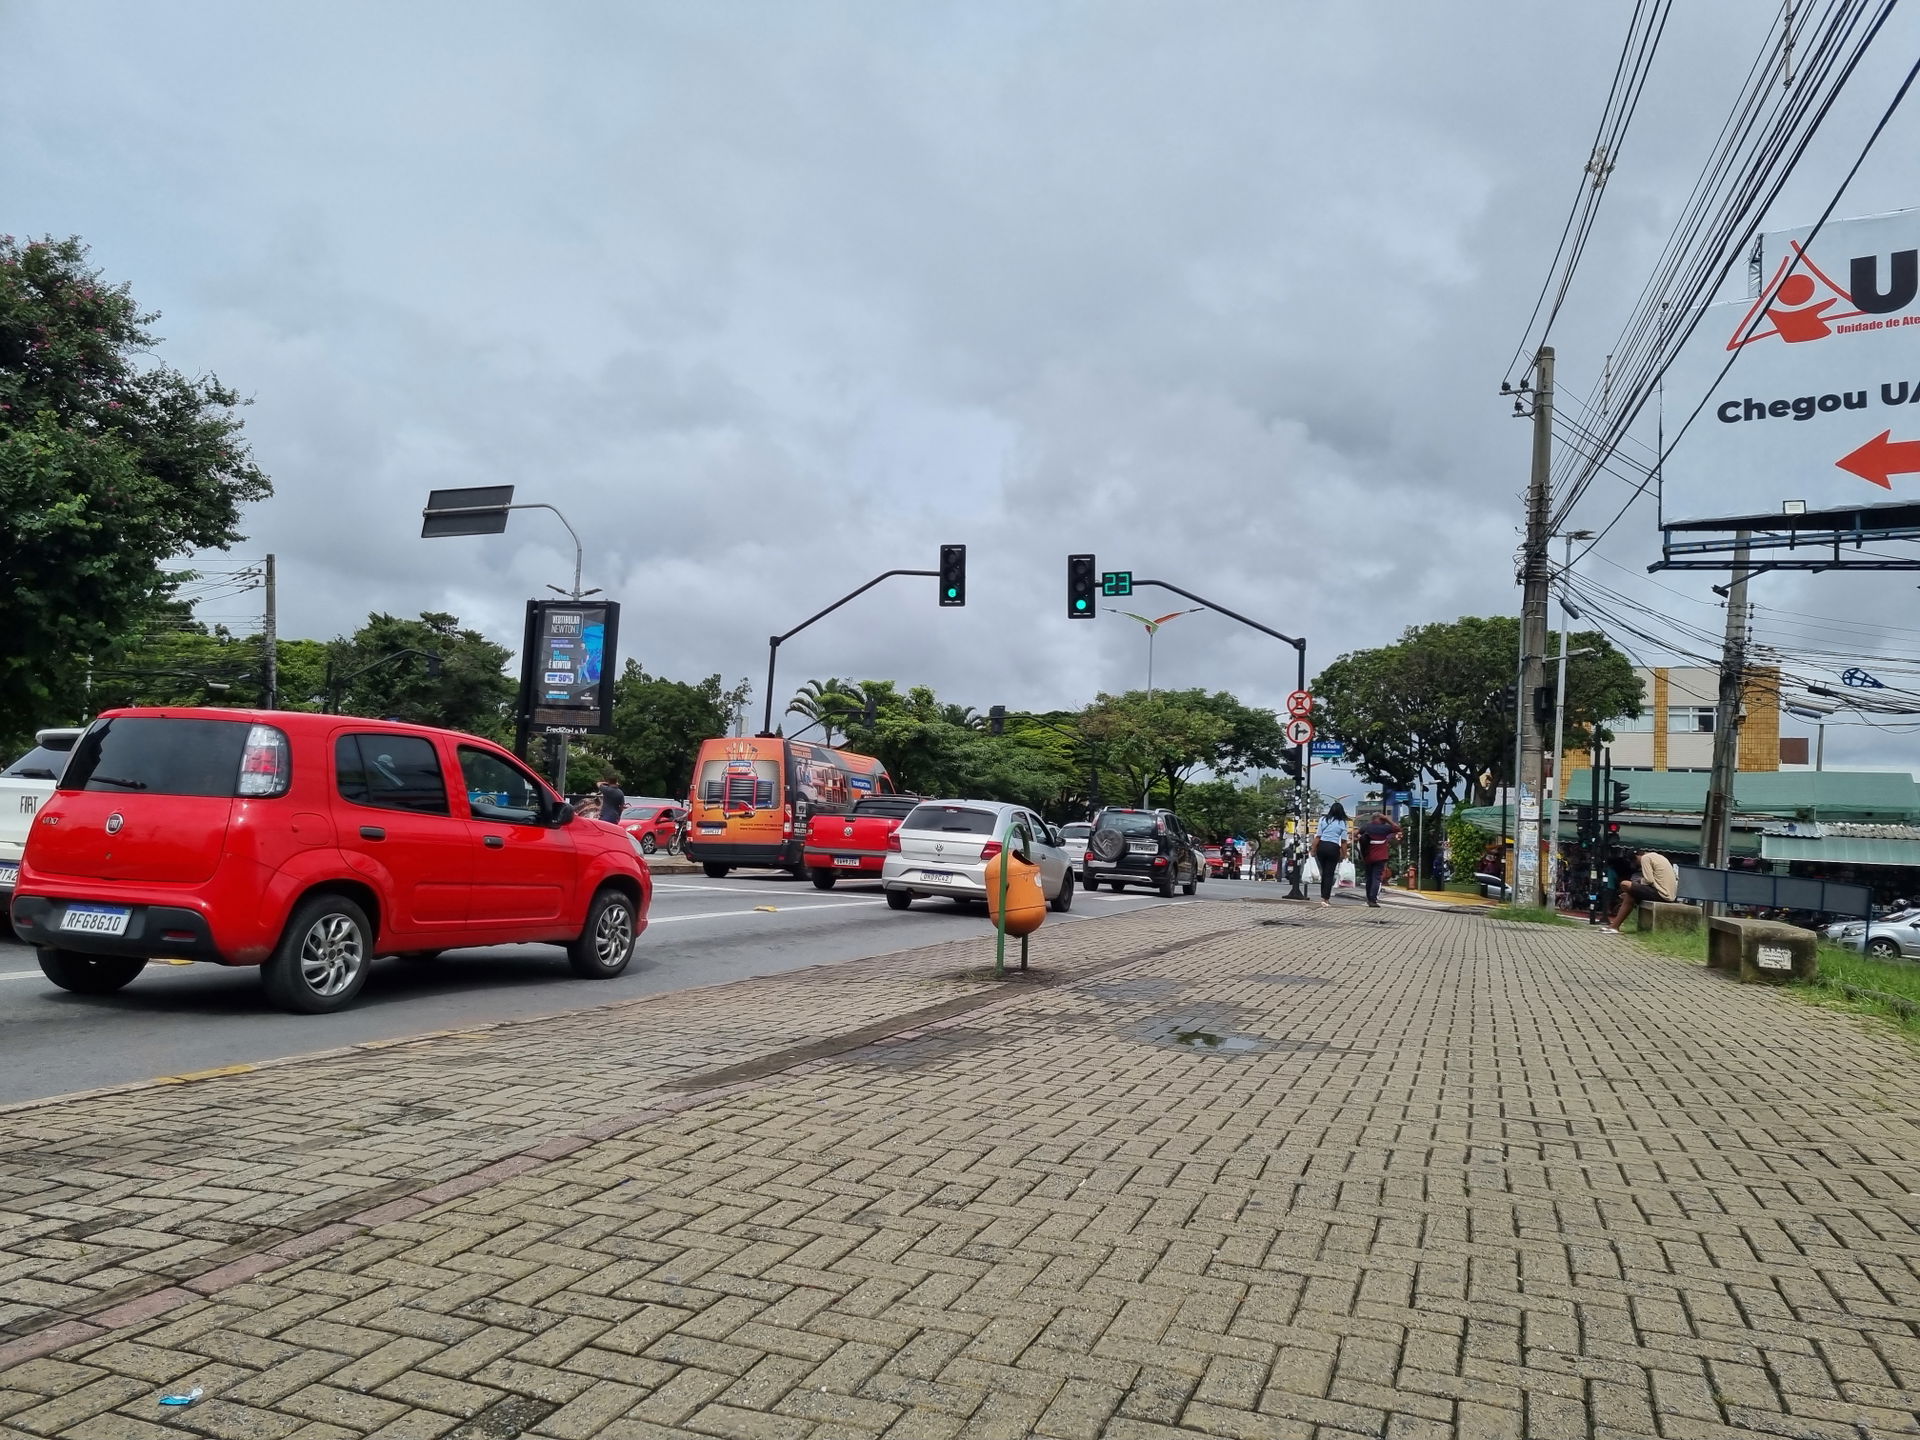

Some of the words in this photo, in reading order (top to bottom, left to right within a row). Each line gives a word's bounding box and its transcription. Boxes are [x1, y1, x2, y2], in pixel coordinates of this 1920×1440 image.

[1837, 320, 1883, 334] Unidade
[1886, 318, 1900, 328] de
[1717, 390, 1868, 423] Chegou
[1105, 574, 1128, 594] 23
[558, 674, 573, 682] 50%
[20, 796, 39, 814] FIAT
[66, 912, 122, 932] RFG8G10
